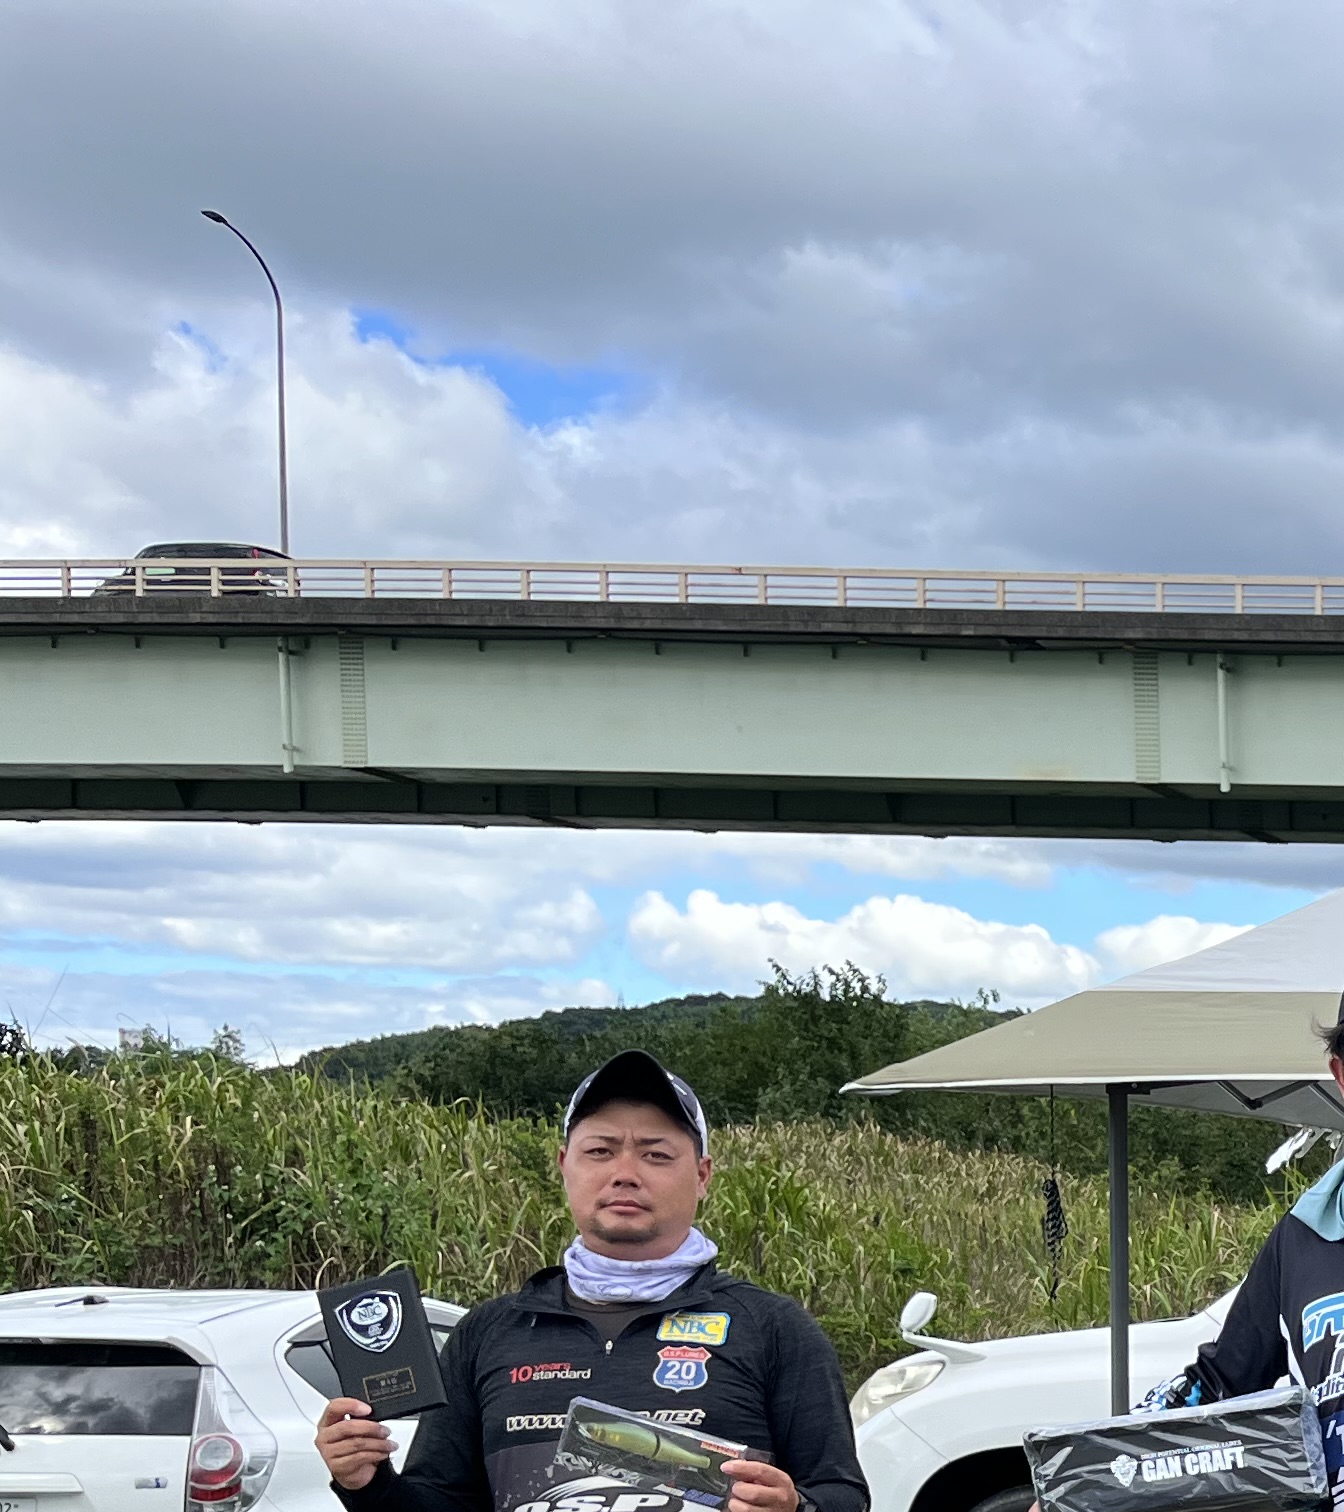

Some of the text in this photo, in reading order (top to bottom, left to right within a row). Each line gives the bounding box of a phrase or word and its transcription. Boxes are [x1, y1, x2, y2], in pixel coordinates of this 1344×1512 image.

[357, 1304, 382, 1319] NBC
[670, 1319, 720, 1338] NBC
[509, 1365, 532, 1383] 10
[532, 1368, 592, 1381] standard
[534, 1362, 571, 1372] years
[664, 1360, 697, 1380] 20
[1141, 1446, 1245, 1483] GAN CRAFT
